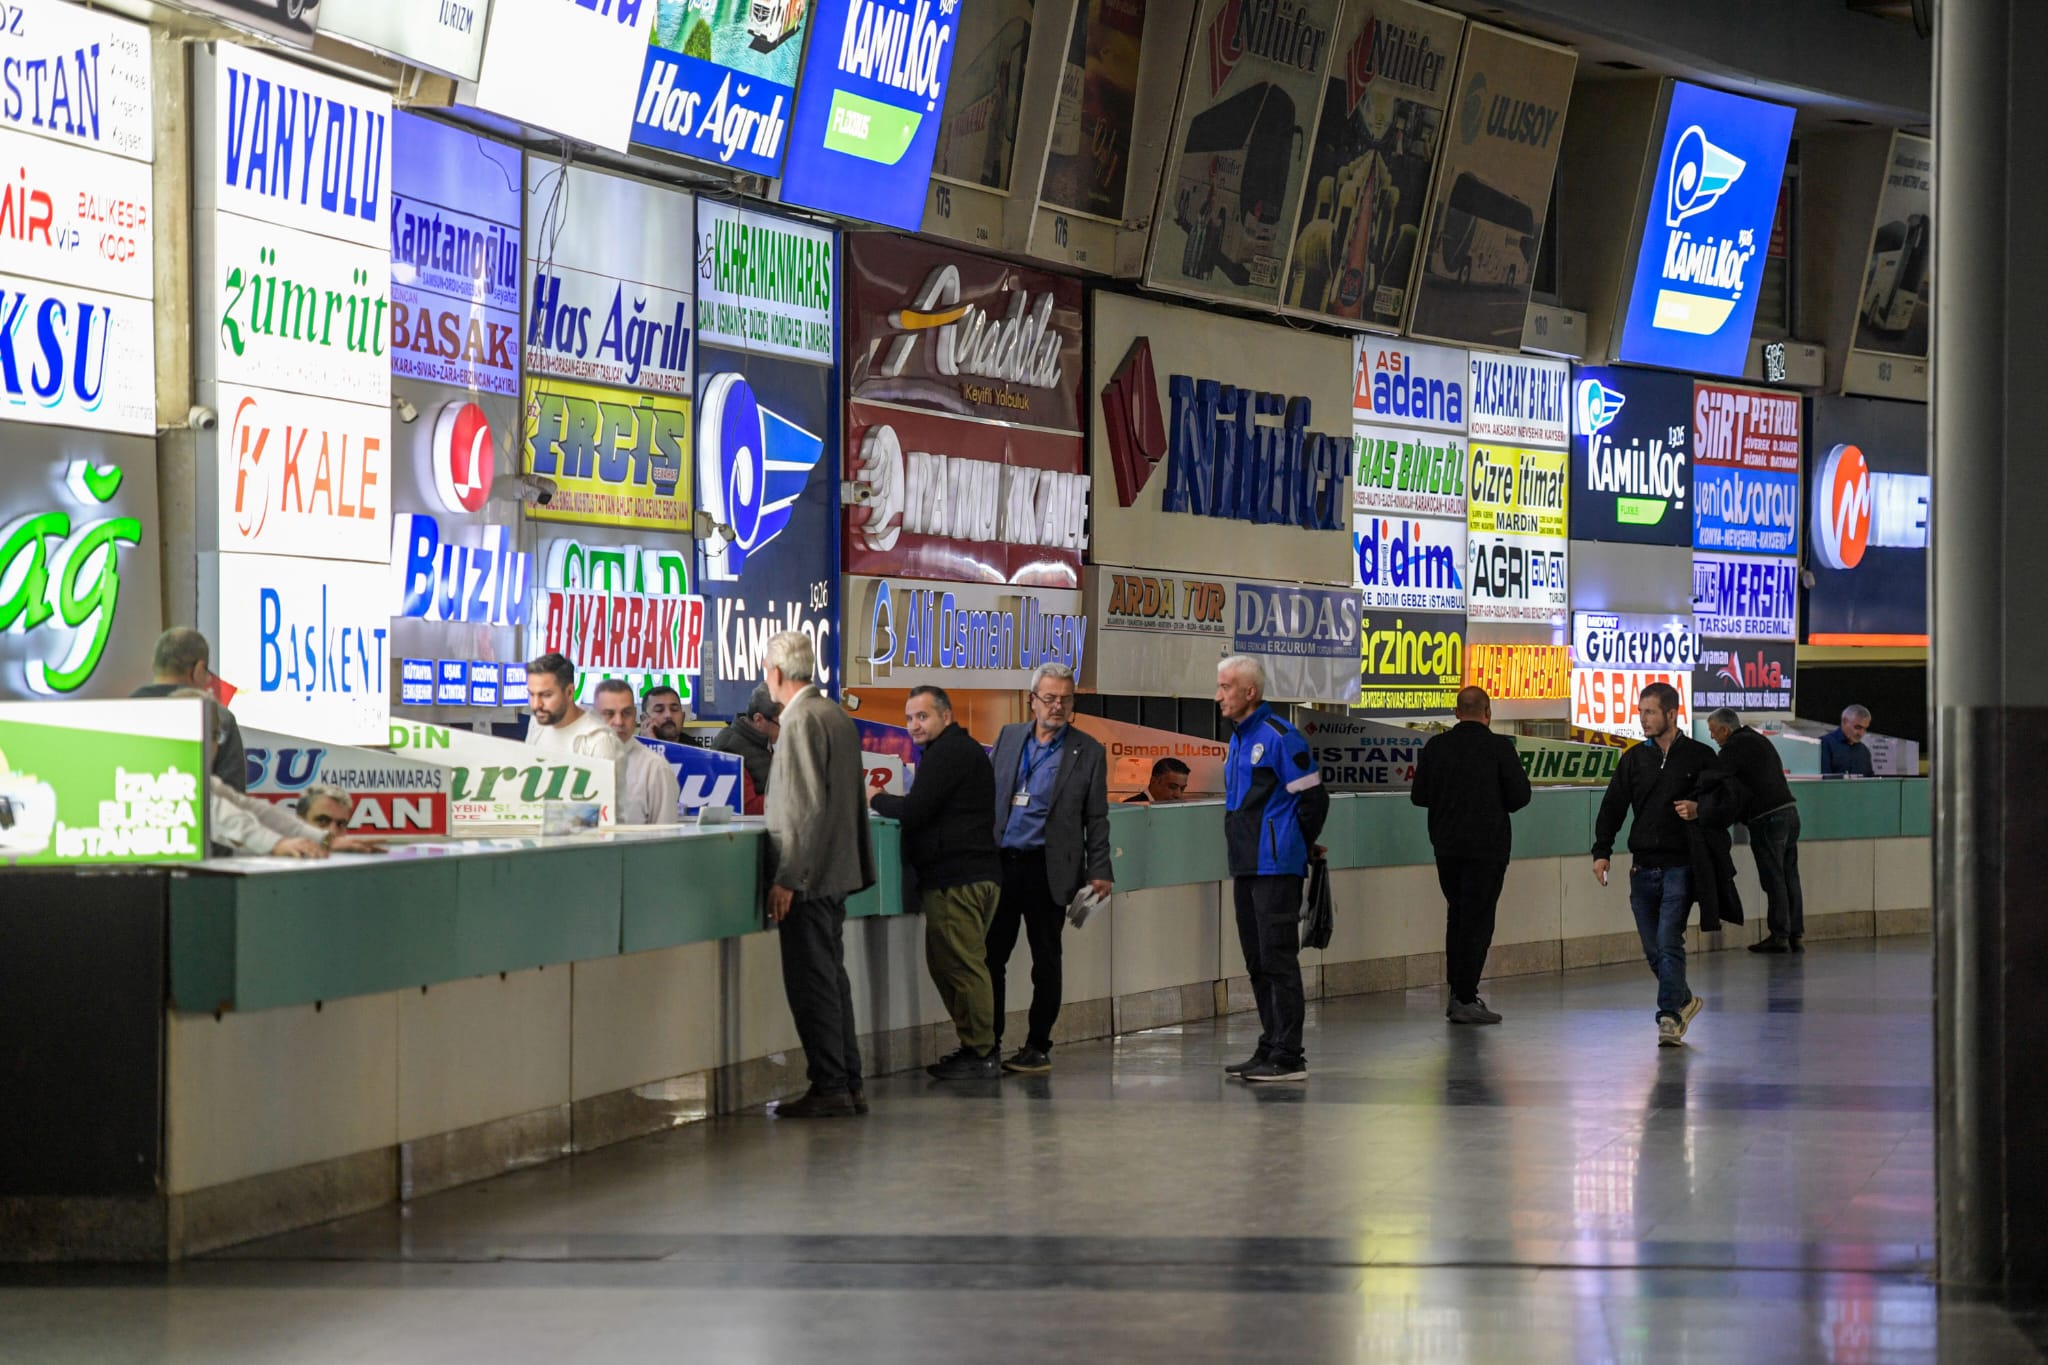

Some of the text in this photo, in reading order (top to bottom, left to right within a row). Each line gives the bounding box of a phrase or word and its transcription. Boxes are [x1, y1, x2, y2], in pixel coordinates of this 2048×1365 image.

[1232, 0, 1325, 73] Nilüfer
[1365, 19, 1445, 93] Nilüfer
[636, 59, 785, 162] Has Ağrılı
[1485, 94, 1559, 149] ULUSOY
[226, 66, 385, 222] VANYOLU
[78, 191, 146, 232] BALIKESİR
[936, 184, 951, 219] 175
[391, 197, 519, 295] Kaptanoğlu
[1055, 215, 1068, 249] 176
[714, 218, 831, 319] KAHRAMANMARAŞ
[391, 300, 514, 371] BAŞAK
[527, 273, 691, 385] Has Ağrılı
[1376, 350, 1402, 372] AS
[1373, 356, 1462, 424] adana
[1473, 360, 1528, 419] AKSARAY
[1749, 396, 1798, 437] PETROL
[530, 391, 685, 496] ERCİŞ
[1471, 422, 1492, 434] KONYA
[281, 425, 381, 520] KALE
[1357, 437, 1399, 489] HAS
[1397, 438, 1465, 497] BİNGÖL
[1471, 450, 1514, 505] Cizre
[1359, 518, 1454, 591] didim
[1699, 526, 1722, 546] KONYA
[400, 513, 534, 626] Buzlu
[1472, 537, 1529, 599] AĞRI
[1717, 559, 1797, 619] MERSİN
[1107, 574, 1226, 623] ARDA TUR
[1236, 590, 1357, 647] DADAŞ
[1401, 595, 1427, 608] GEBZE
[1700, 617, 1742, 633] TARSUS
[903, 590, 1087, 686] Ali Osman Ulusoy
[1267, 640, 1316, 655] ERZURUM
[1111, 742, 1170, 757] Osman
[1173, 741, 1228, 761] Ulusoy
[1318, 723, 1366, 735] Nilüfer
[1360, 737, 1424, 746] BURSA
[321, 768, 442, 793] KAHRAMANMARAŞ
[56, 821, 197, 857] İSTANBUL
[99, 800, 197, 828] BURSA
